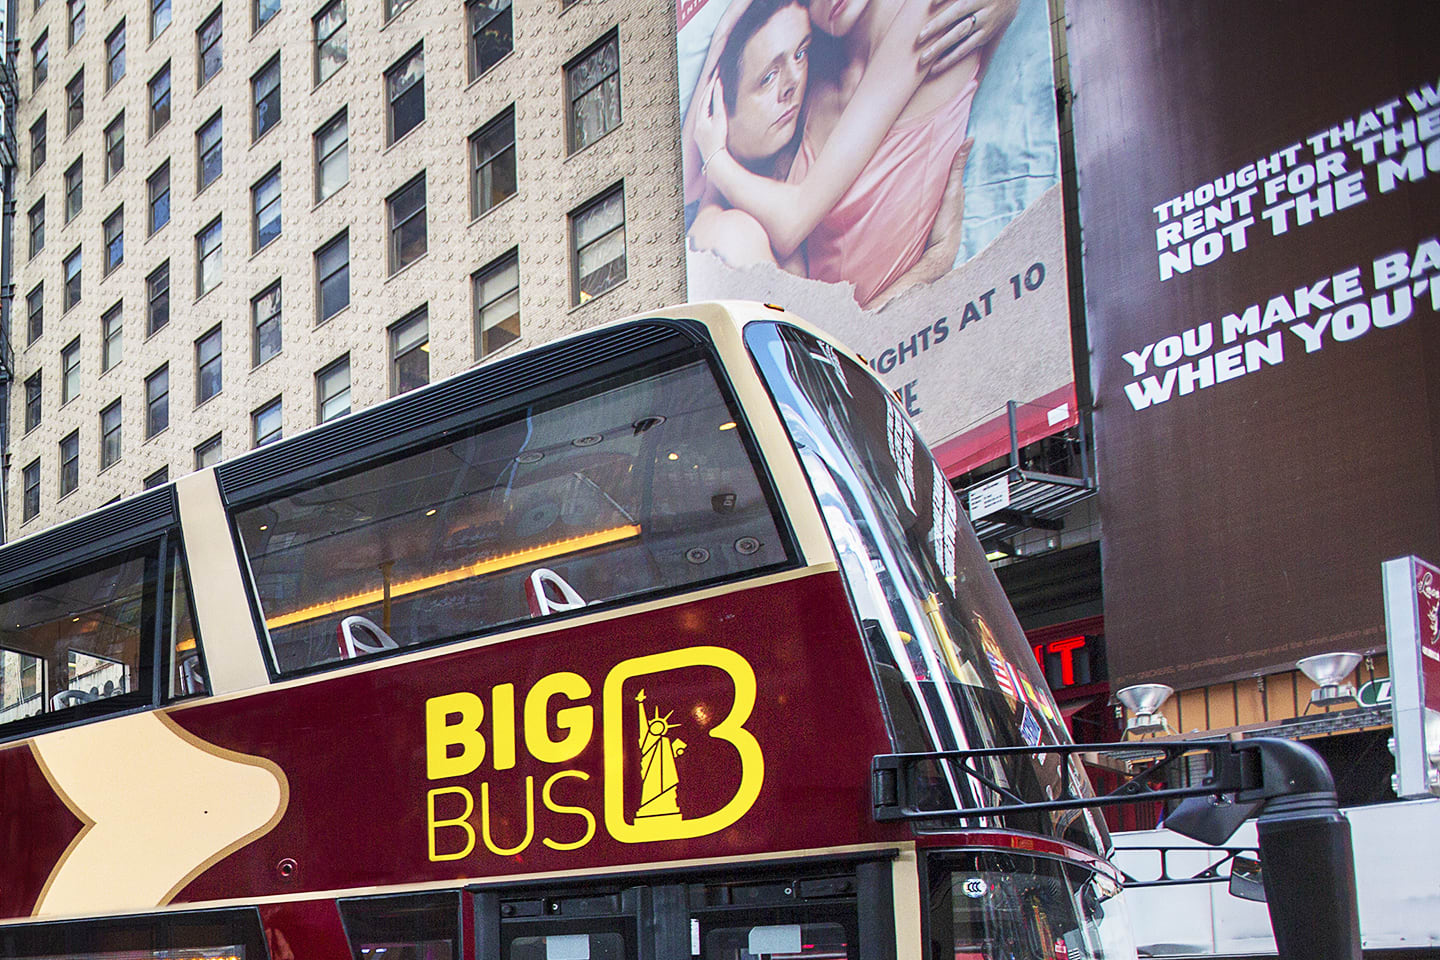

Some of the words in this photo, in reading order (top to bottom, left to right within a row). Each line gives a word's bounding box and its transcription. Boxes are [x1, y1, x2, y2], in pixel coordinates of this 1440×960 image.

[1153, 142, 1302, 223] THOUGHT
[1307, 98, 1401, 156] THAT
[1406, 79, 1440, 113] W
[1156, 186, 1258, 251] RENT
[1264, 151, 1347, 205] FOR
[1158, 215, 1256, 282] NOT
[1262, 170, 1368, 236] THE
[959, 288, 996, 332] AT
[1010, 262, 1046, 300] 10
[1121, 322, 1214, 377] YOU
[1221, 266, 1363, 344] MAKE
[1123, 331, 1285, 412] WHEN
[425, 671, 594, 780] BIG
[427, 769, 596, 862] BUS
